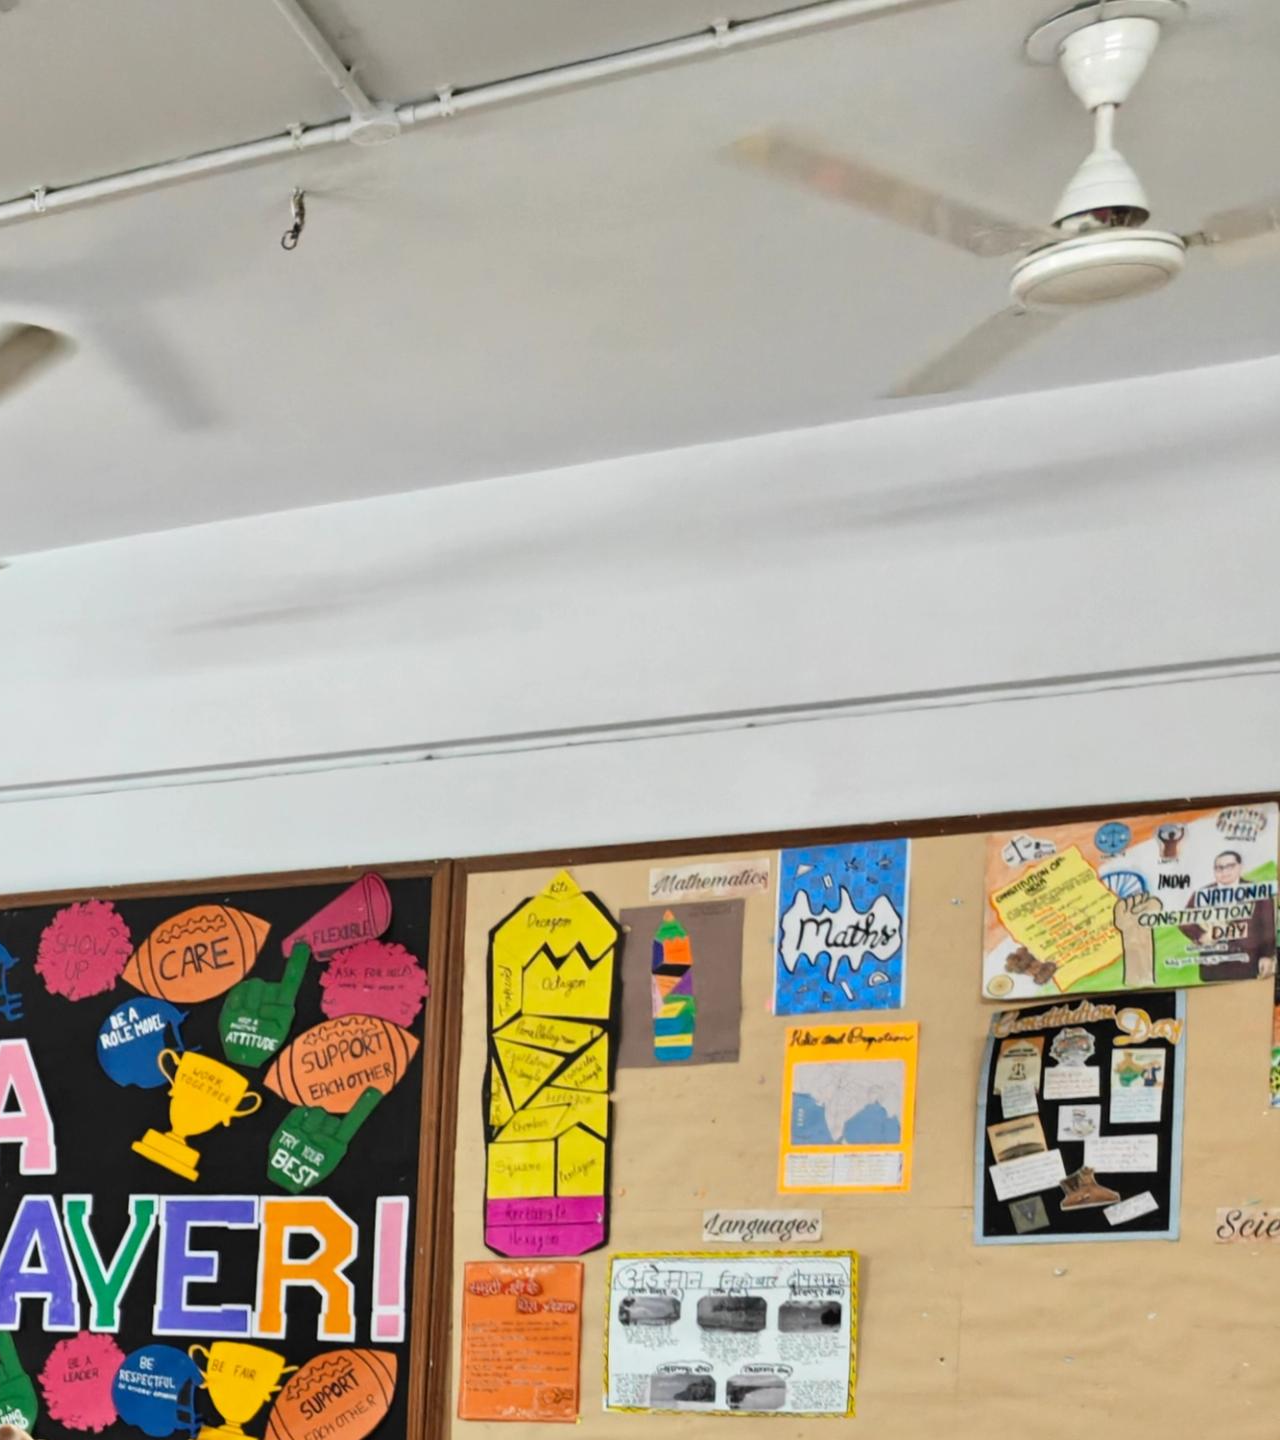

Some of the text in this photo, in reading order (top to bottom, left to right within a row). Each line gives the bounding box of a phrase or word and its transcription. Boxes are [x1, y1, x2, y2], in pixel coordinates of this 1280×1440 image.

[651, 869, 768, 897] Mathematics
[1157, 872, 1191, 890] INDIA
[1196, 884, 1274, 908] NATIONAL
[527, 913, 573, 934] Decagon
[1137, 903, 1255, 927] CONSTITUTION
[795, 912, 897, 951] Maths
[1211, 925, 1247, 940] DAY
[53, 933, 111, 955] SHOW
[65, 960, 90, 981] UP
[158, 936, 236, 982] CARE
[541, 976, 587, 998] Octagon
[109, 1006, 140, 1031] BE A
[993, 999, 1184, 1047] Constitution Day
[99, 1013, 166, 1050] ROLE MODEL
[225, 1031, 280, 1052] ATTITUDE
[301, 1032, 384, 1074] SUPPORT
[192, 1067, 224, 1087] WORK
[307, 1061, 394, 1101] EACH OTHER
[180, 1073, 232, 1105] TOGETHER
[278, 1129, 301, 1150] TRY
[270, 1148, 320, 1188] BEST
[494, 1159, 542, 1178] Square
[704, 1212, 820, 1243] Languages
[67, 1356, 93, 1371] BE A
[139, 1355, 155, 1371] BE
[211, 1358, 257, 1381] BE FAIR
[62, 1368, 100, 1384] LEADER
[118, 1368, 177, 1390] RESPECTFUL
[300, 1368, 361, 1421] SUPPORT
[334, 1394, 378, 1431] OTHER
